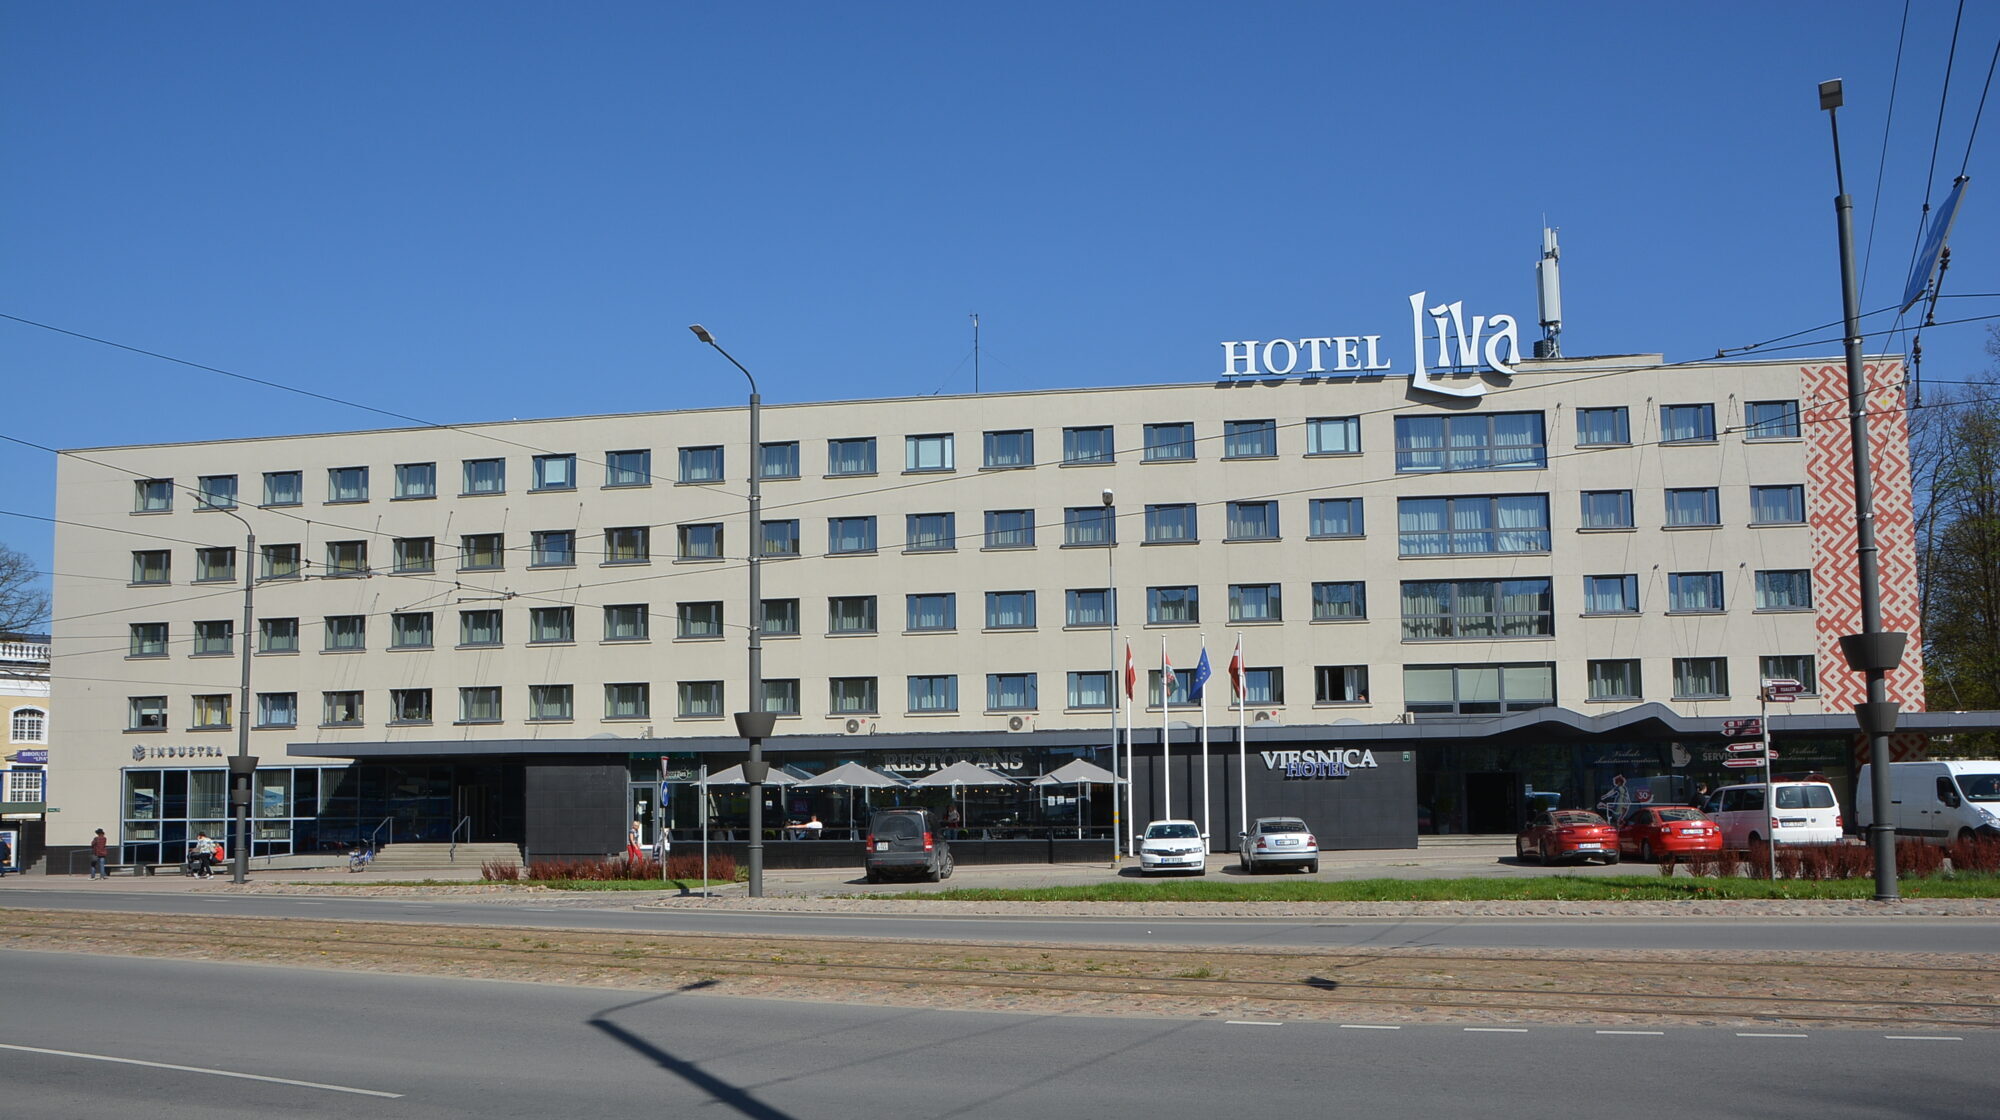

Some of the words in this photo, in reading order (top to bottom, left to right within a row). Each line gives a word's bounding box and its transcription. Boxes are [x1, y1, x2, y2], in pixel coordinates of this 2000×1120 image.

[1220, 335, 1391, 377] HOTEL
[150, 745, 223, 758] INDUSTRA
[1702, 752, 1739, 761] SERVISS
[1286, 762, 1350, 777] HOTEL
